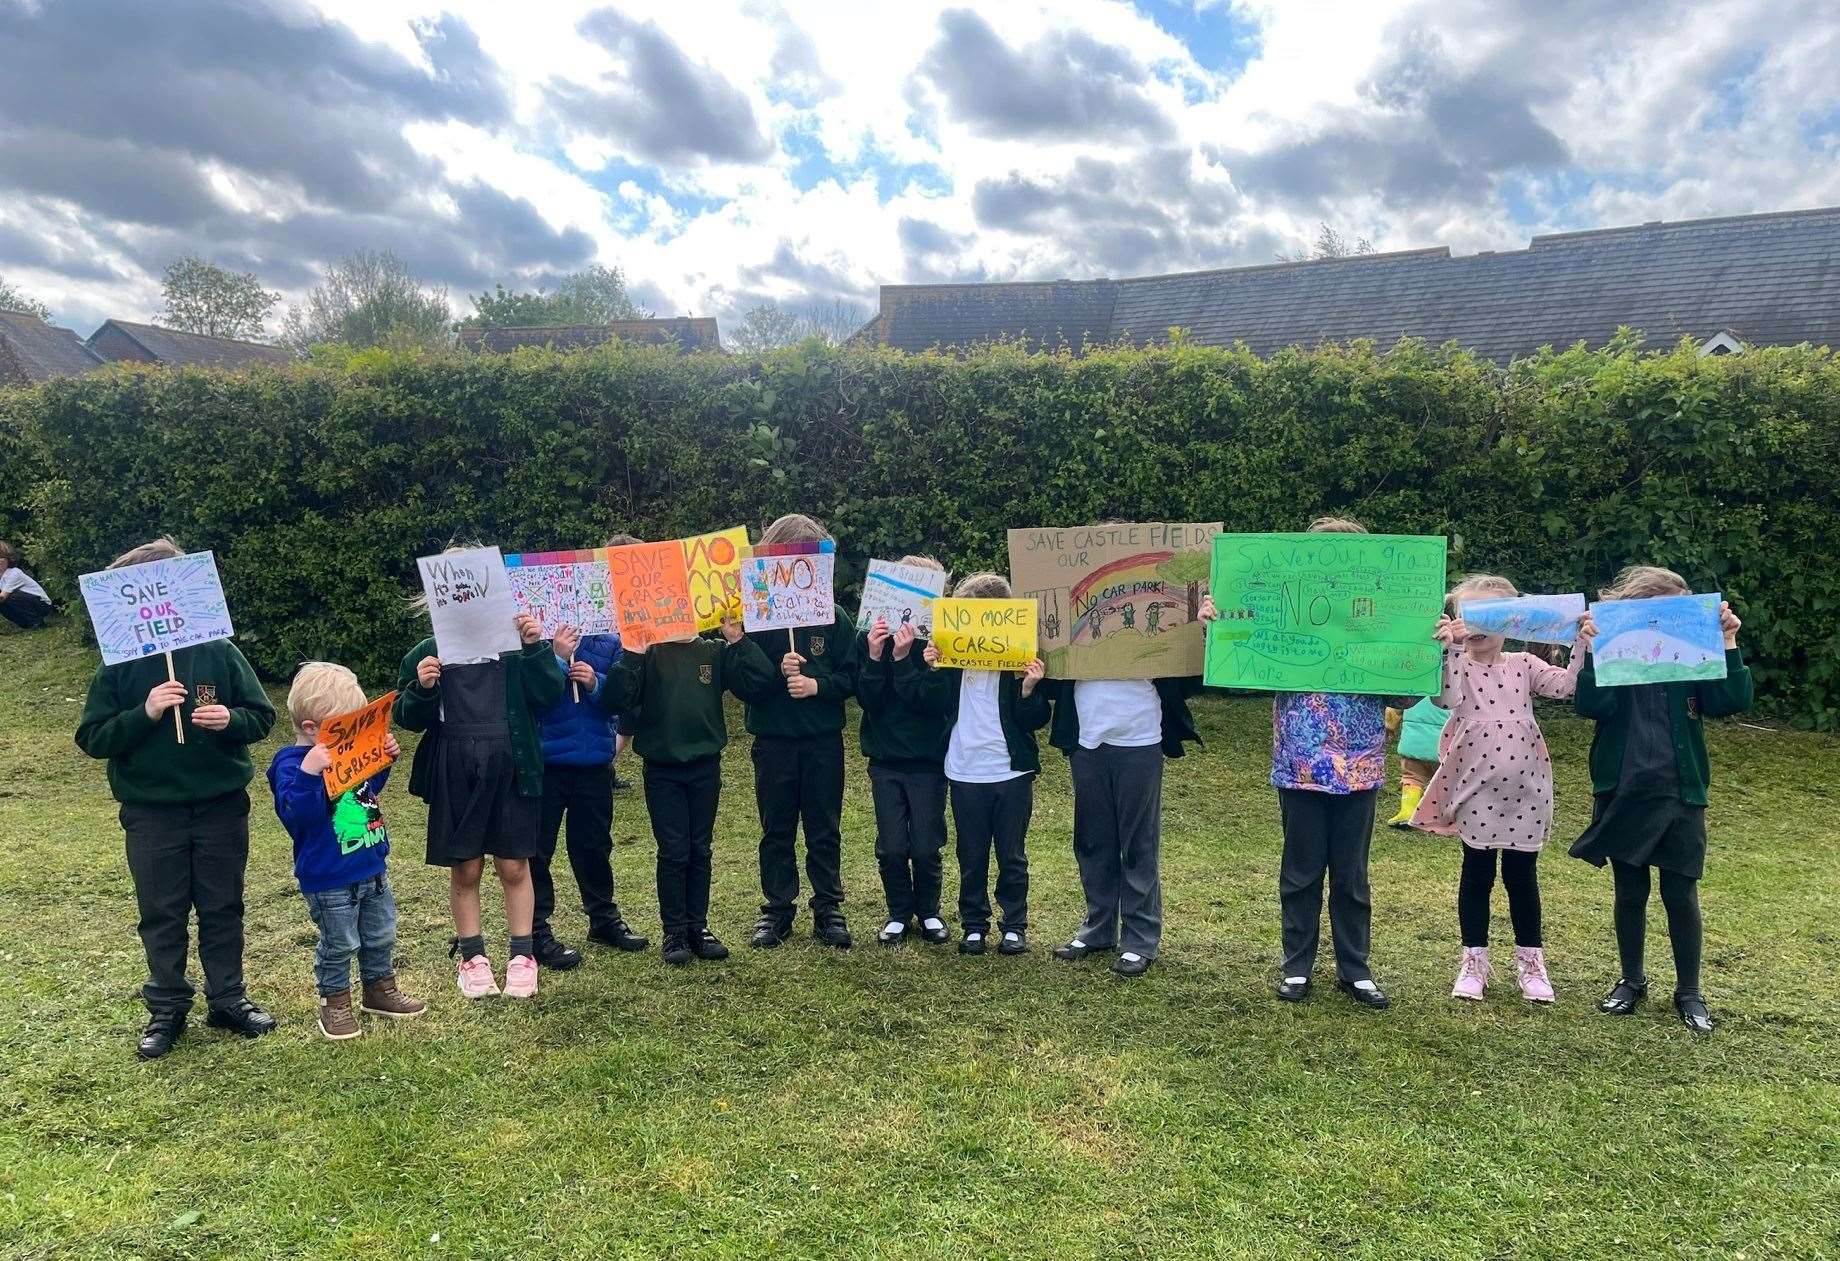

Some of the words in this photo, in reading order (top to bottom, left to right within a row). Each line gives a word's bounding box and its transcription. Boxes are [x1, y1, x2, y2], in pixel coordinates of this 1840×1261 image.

[1026, 532, 1065, 551] SAVE
[1073, 528, 1139, 549] CASTLE
[1150, 524, 1217, 549] FIELDS
[613, 547, 672, 576] SAVE
[684, 537, 736, 571] NO
[1057, 551, 1090, 566] OUR
[1237, 543, 1304, 573] Save
[630, 571, 662, 588] OUR
[773, 557, 813, 589] NO
[120, 581, 168, 605] SAVE
[1074, 591, 1098, 618] No
[1102, 582, 1128, 600] CAR
[1280, 578, 1332, 627] NO
[139, 601, 178, 620] OUR
[943, 605, 971, 631] NO
[980, 607, 1029, 627] MORE
[134, 616, 185, 644] FIELD
[208, 627, 229, 638] PARK
[953, 635, 1010, 653] CARS!
[960, 658, 993, 666] CASTLE
[997, 659, 1027, 668] FIELDS
[1322, 666, 1367, 687] Cars
